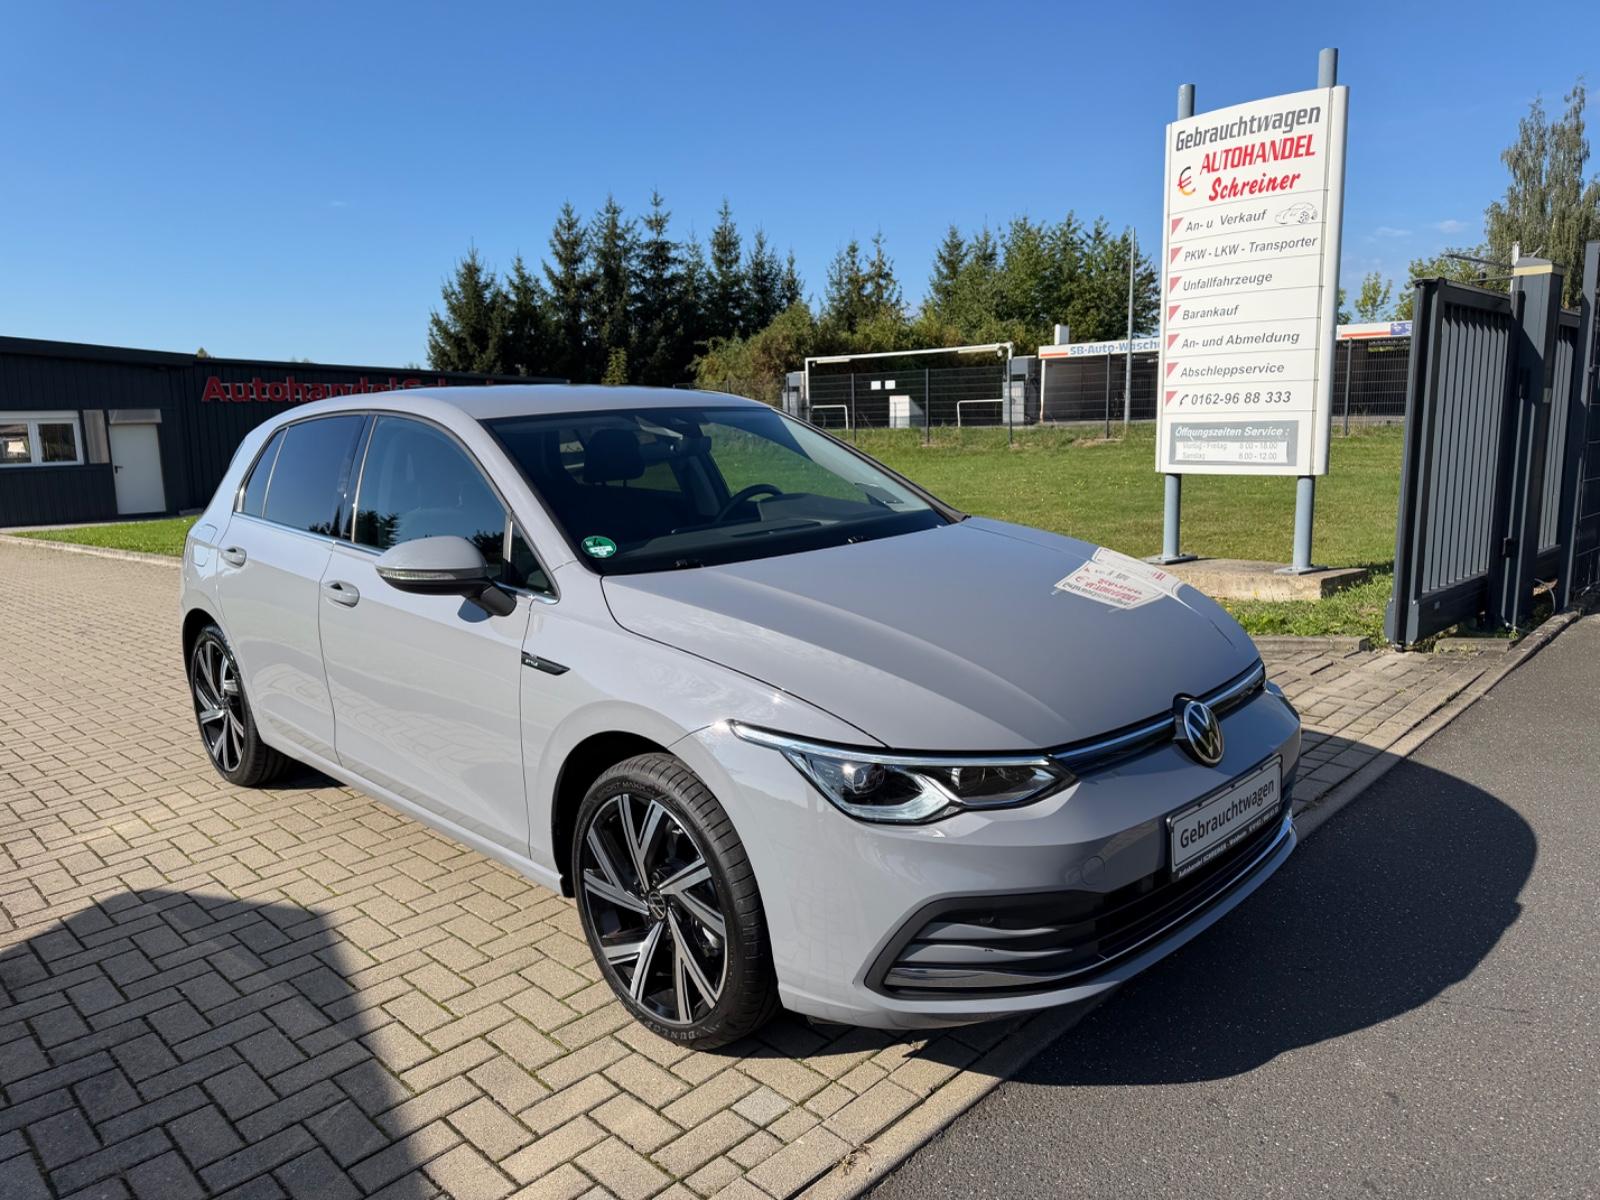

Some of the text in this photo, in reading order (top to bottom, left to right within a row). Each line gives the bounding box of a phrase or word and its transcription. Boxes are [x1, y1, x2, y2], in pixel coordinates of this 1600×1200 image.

[1176, 106, 1321, 151] Gebrauchtwagen
[1200, 134, 1316, 175] AUTOHANDEL
[1209, 172, 1301, 201] Schreiner
[1185, 209, 1268, 233] An- u Verkauf
[1184, 248, 1208, 262] PKW
[1214, 244, 1240, 258] LKW
[1249, 236, 1318, 254] Transporter
[1183, 272, 1273, 292] Unfallfahrzeuge
[1182, 304, 1240, 320] Barankauf
[1182, 331, 1300, 349] An- und Abmeldung
[1180, 362, 1285, 378] Abschleppservice
[1191, 390, 1292, 405] 0162-96 88 333
[1244, 426, 1283, 437] Service
[1180, 779, 1275, 849] Gebrauchtwagen
